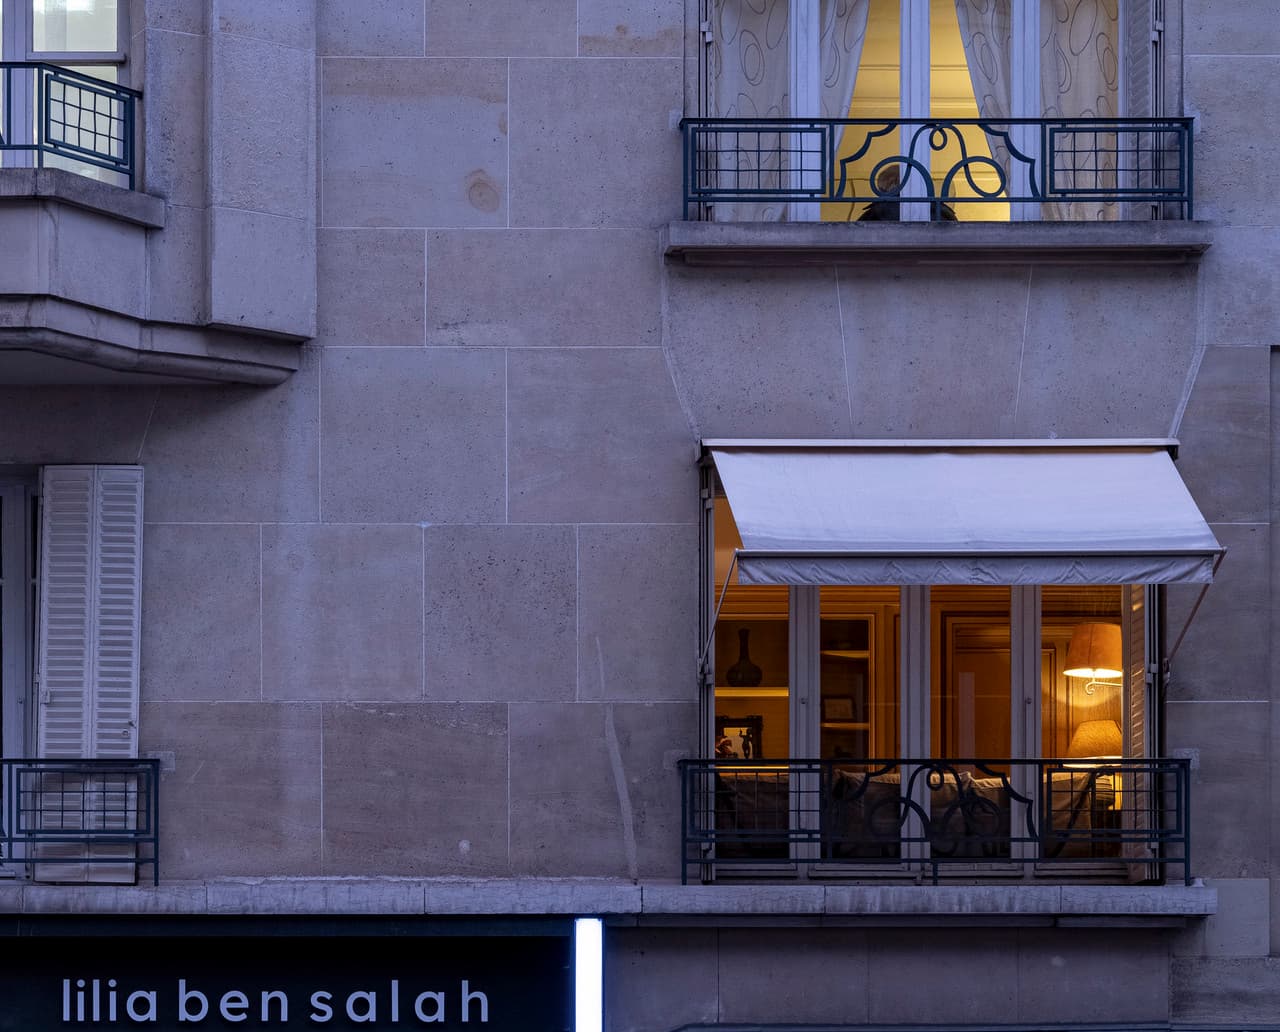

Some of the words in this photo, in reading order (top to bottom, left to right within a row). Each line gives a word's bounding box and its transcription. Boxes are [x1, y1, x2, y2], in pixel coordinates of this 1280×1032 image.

[63, 979, 157, 1022] lilia
[179, 979, 289, 1022] ben
[310, 979, 489, 1023] salah
